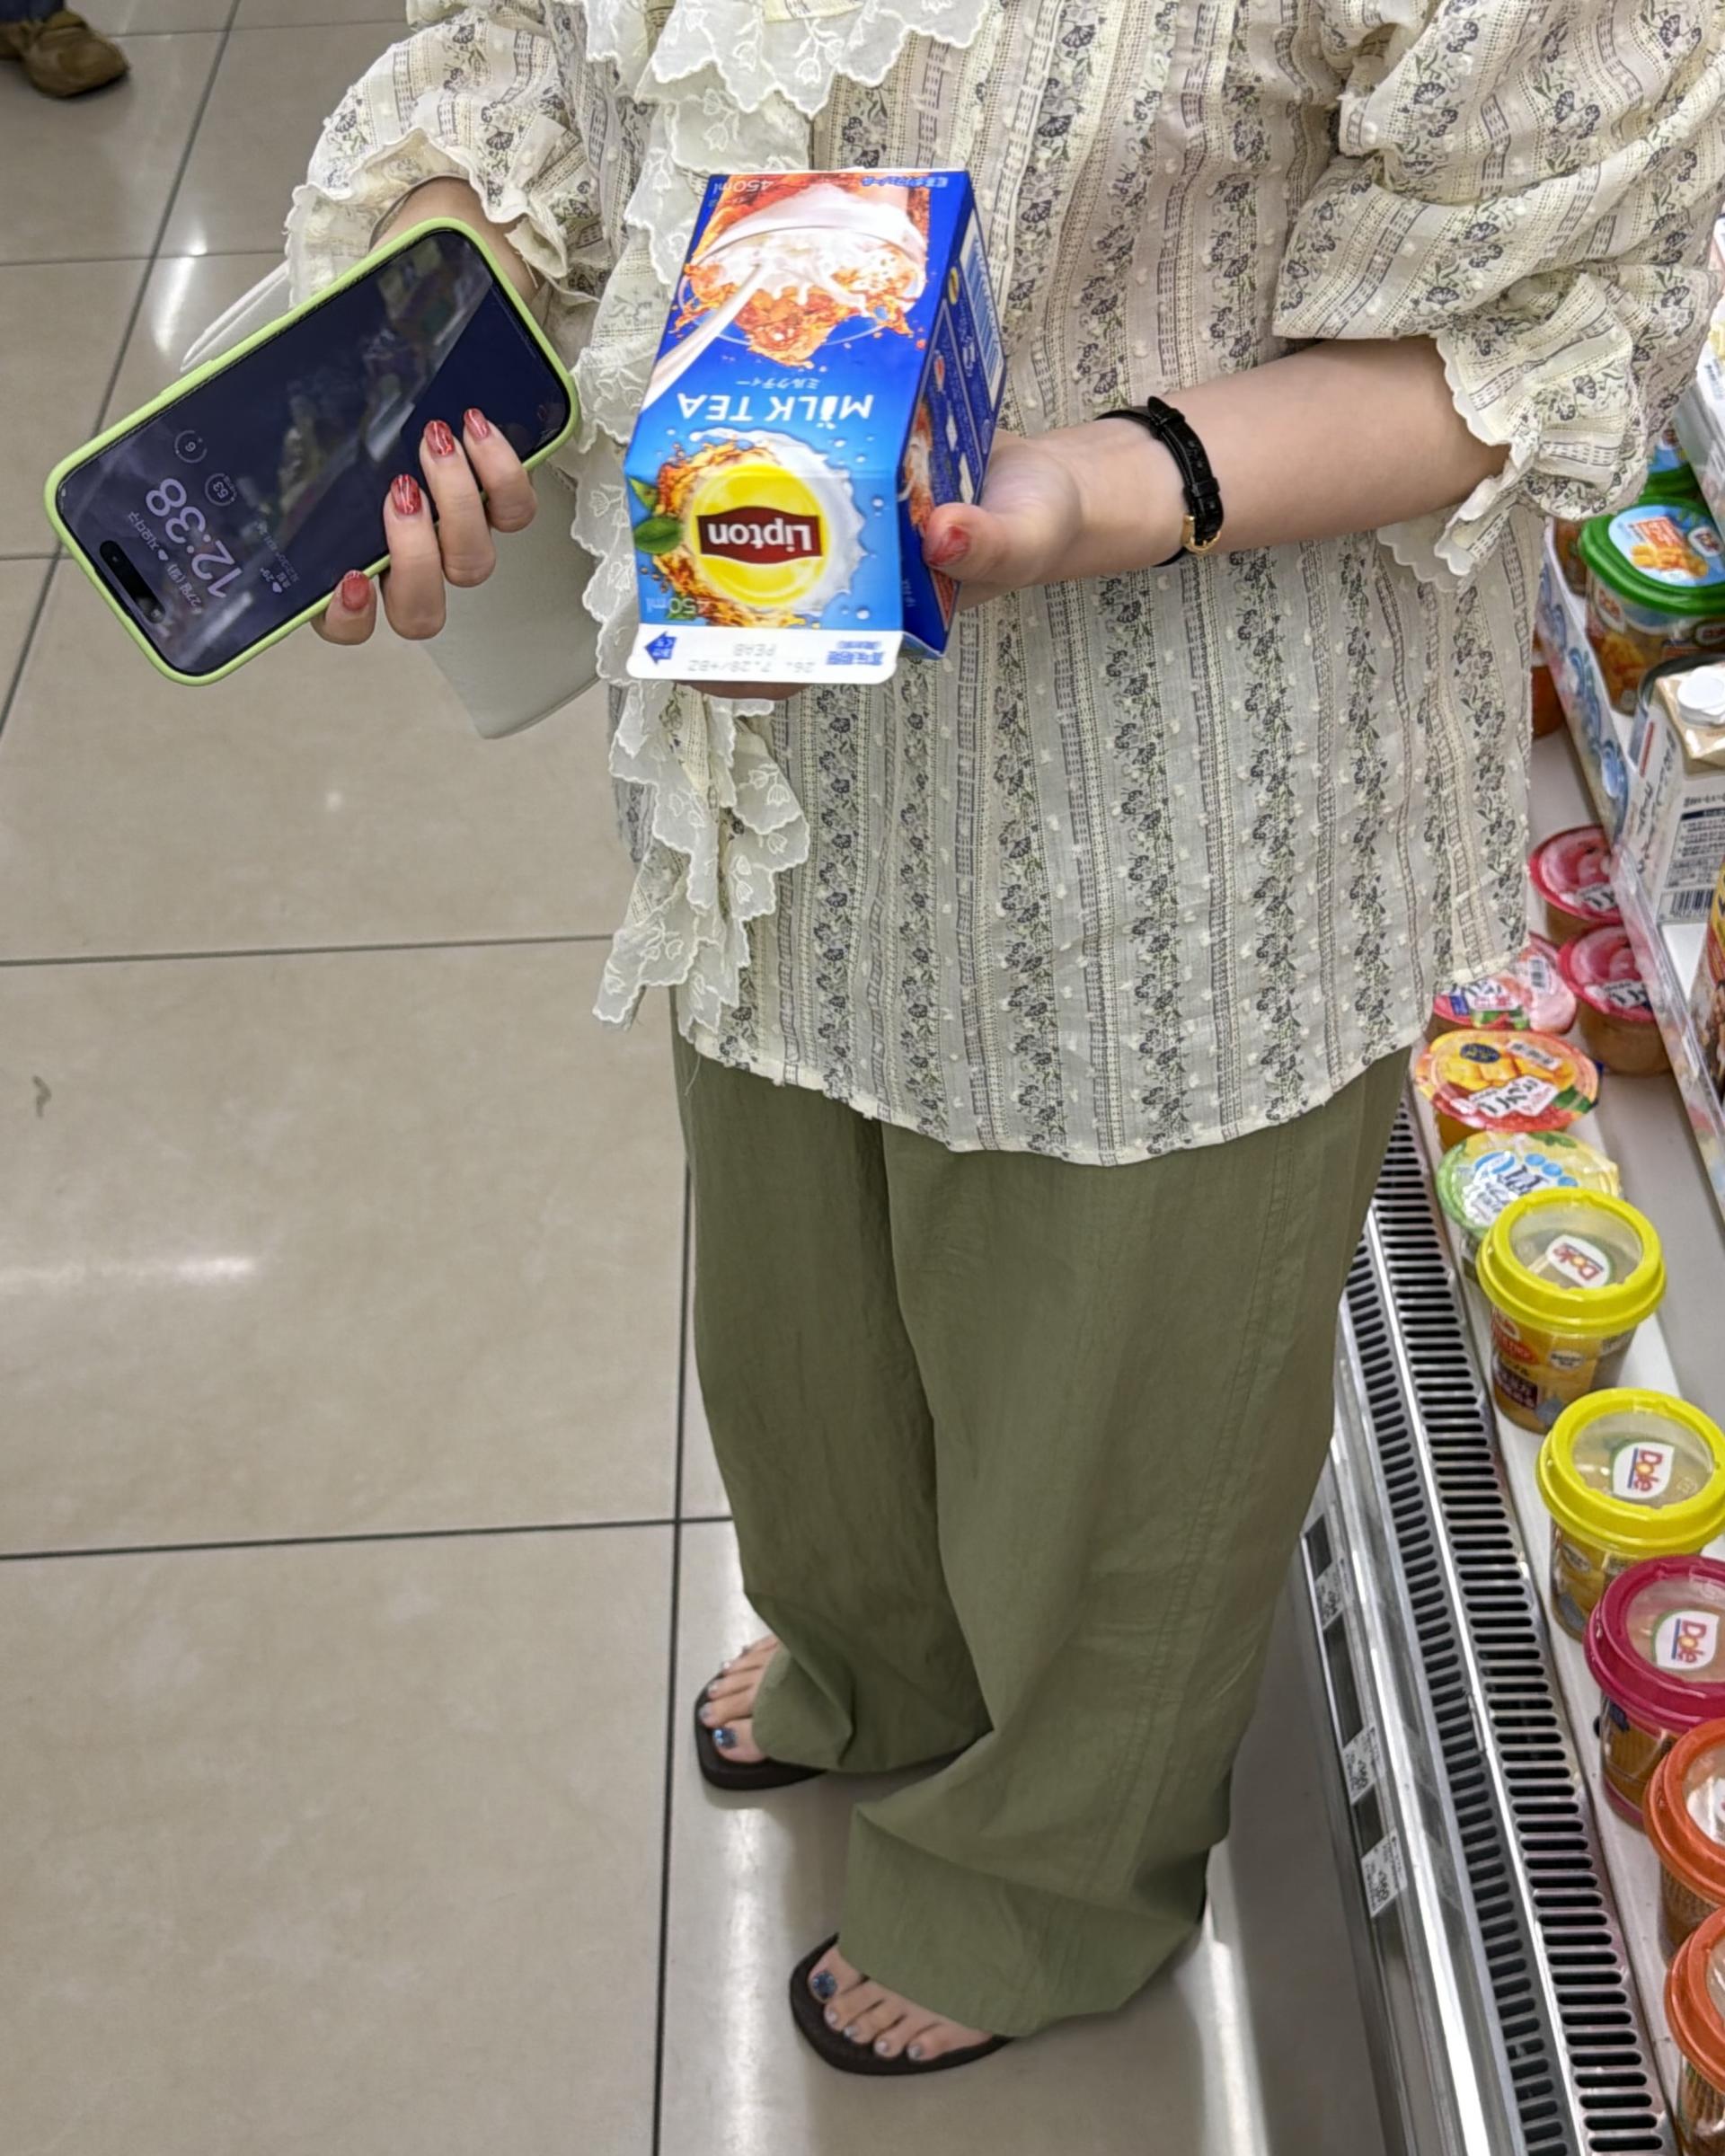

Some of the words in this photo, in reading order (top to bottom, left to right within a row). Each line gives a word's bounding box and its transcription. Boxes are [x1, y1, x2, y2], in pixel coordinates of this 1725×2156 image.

[713, 179, 774, 195] 450ml
[736, 377, 820, 390] ミルクティー
[677, 393, 753, 421] TEA
[765, 394, 874, 429] MILK
[185, 441, 196, 452] 6
[213, 481, 228, 499] 53
[128, 511, 159, 551] 지요다구
[146, 478, 243, 598] 12:38
[707, 517, 812, 552] Lipton
[646, 597, 710, 614] 450ml
[1552, 1243, 1600, 1280] Dole
[1634, 1450, 1663, 1491] Dole
[1677, 1620, 1707, 1663] Dole
